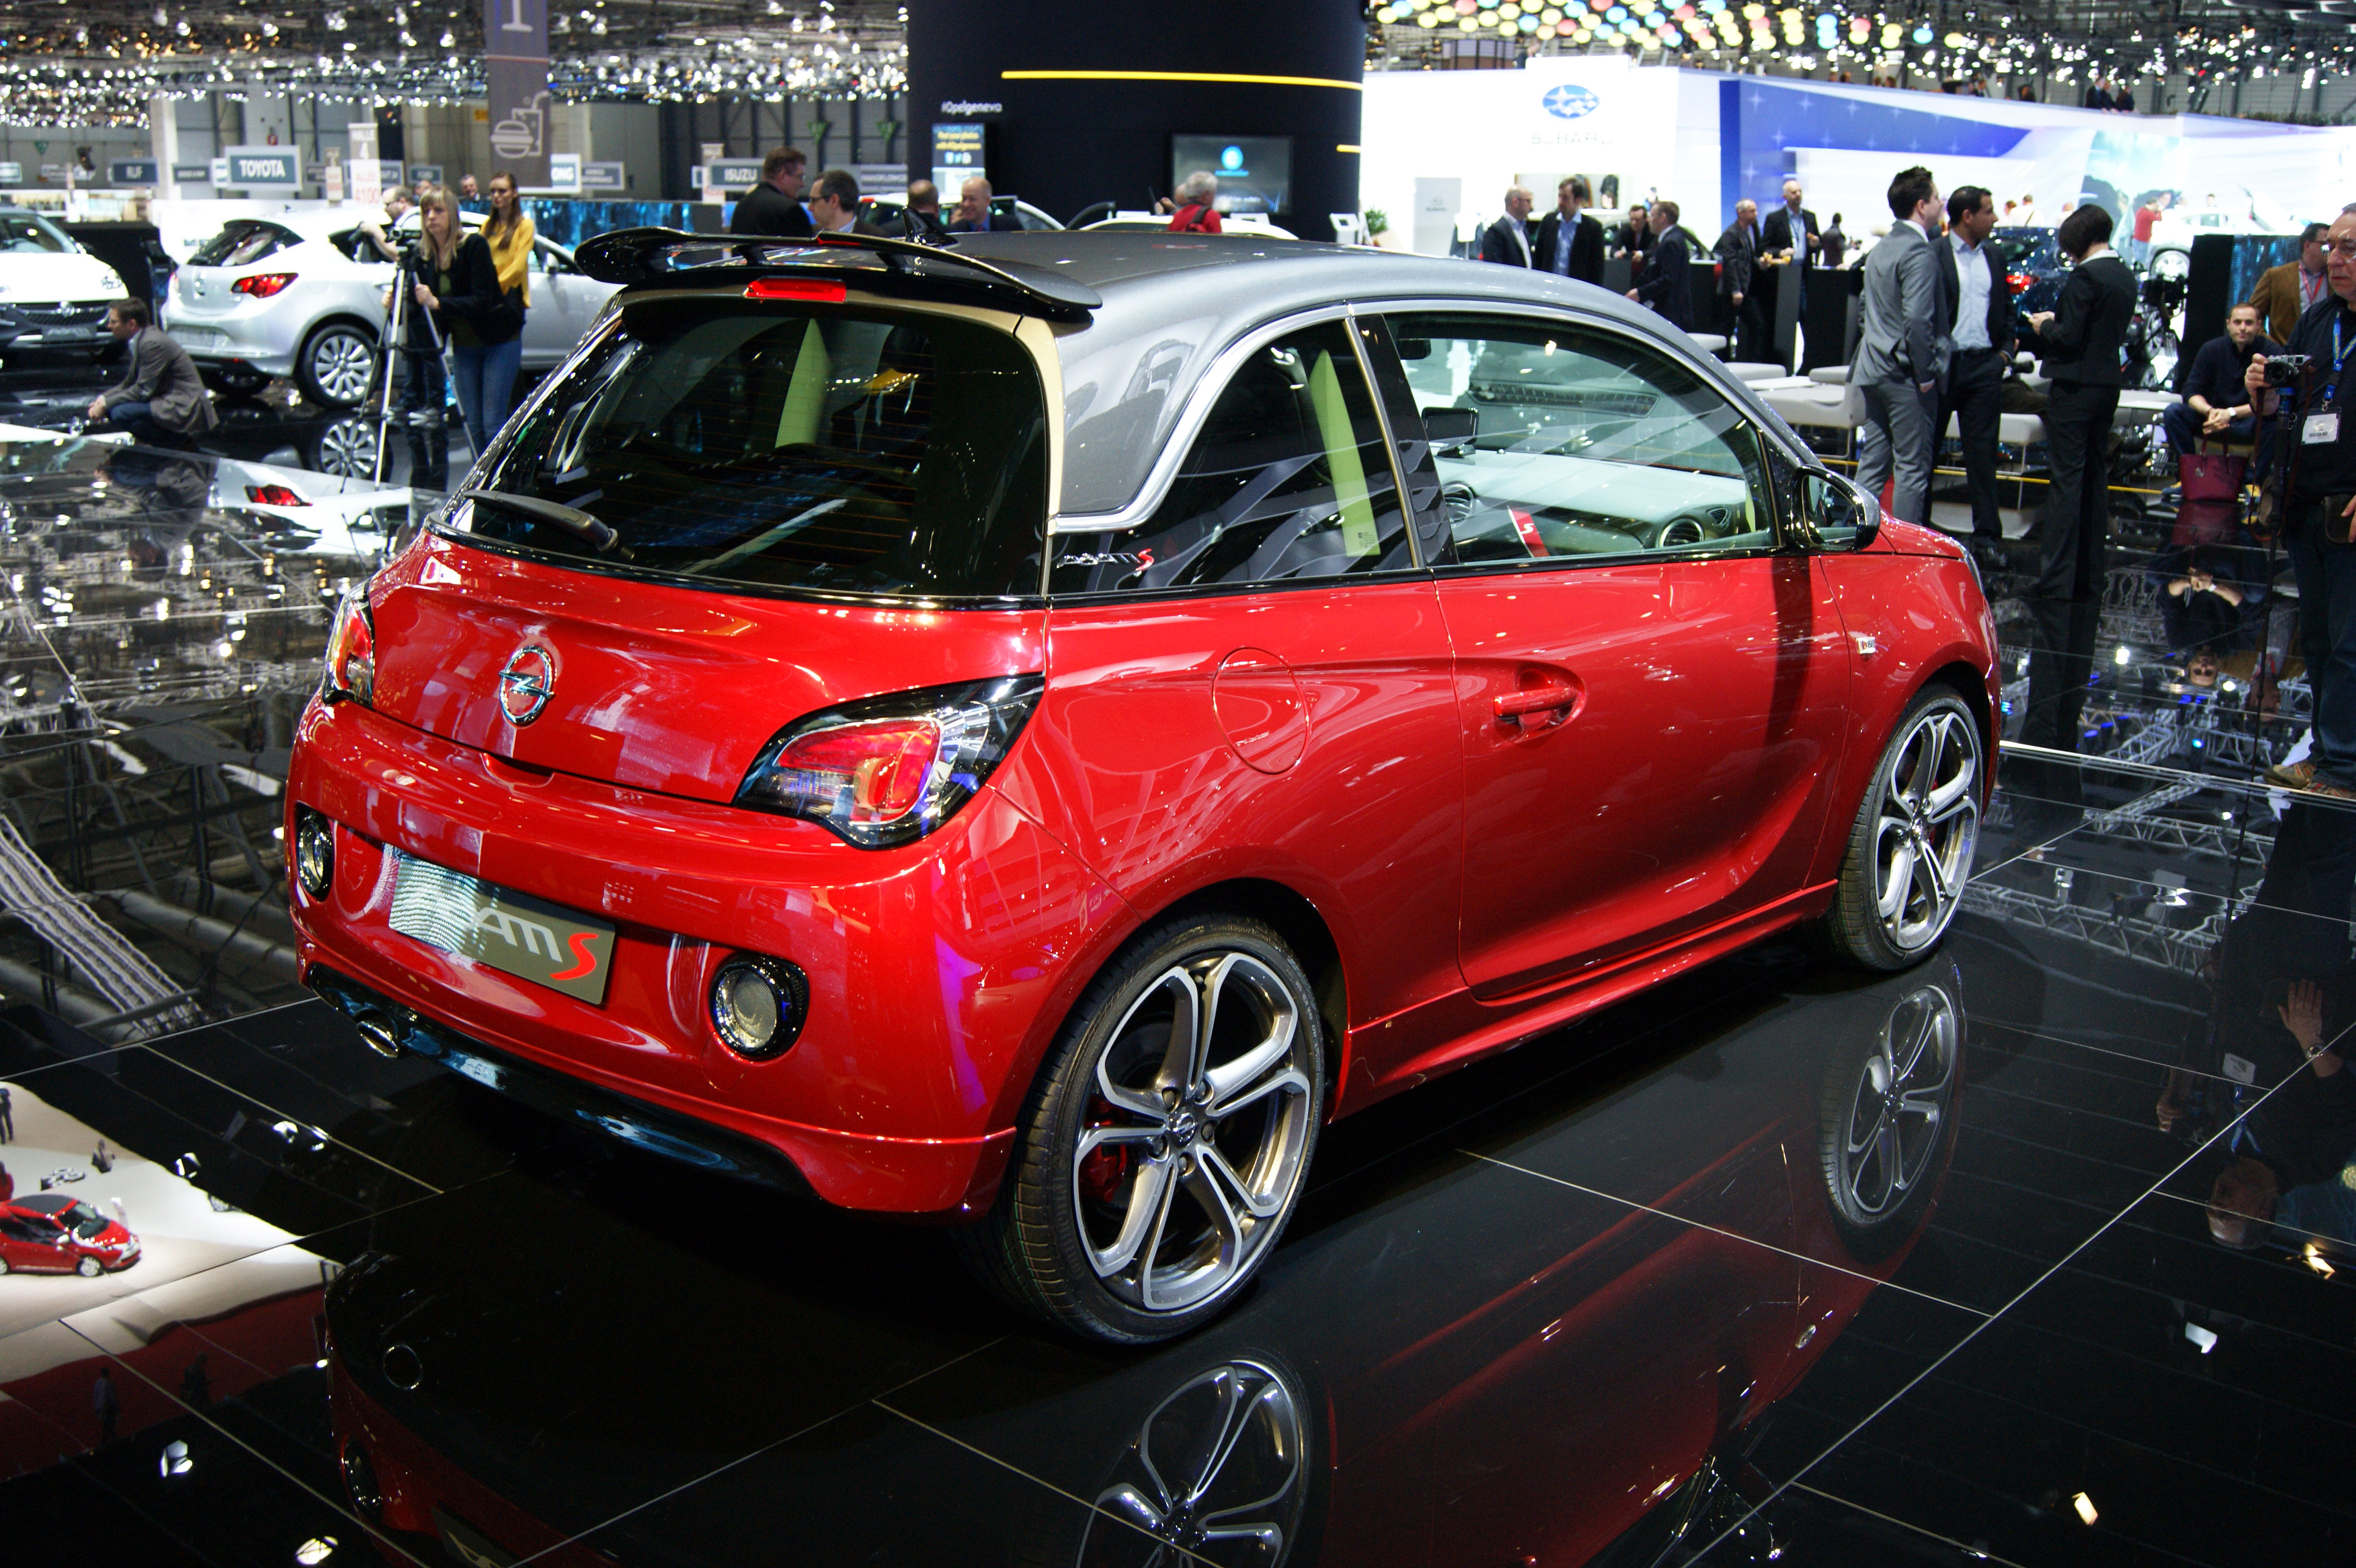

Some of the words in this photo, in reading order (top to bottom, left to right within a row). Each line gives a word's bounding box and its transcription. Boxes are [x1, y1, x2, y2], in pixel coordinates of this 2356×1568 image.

[1532, 132, 1613, 144] SUBARU
[239, 159, 286, 178] TOYOTA
[724, 168, 757, 182] ISUZU
[549, 932, 599, 981] S
